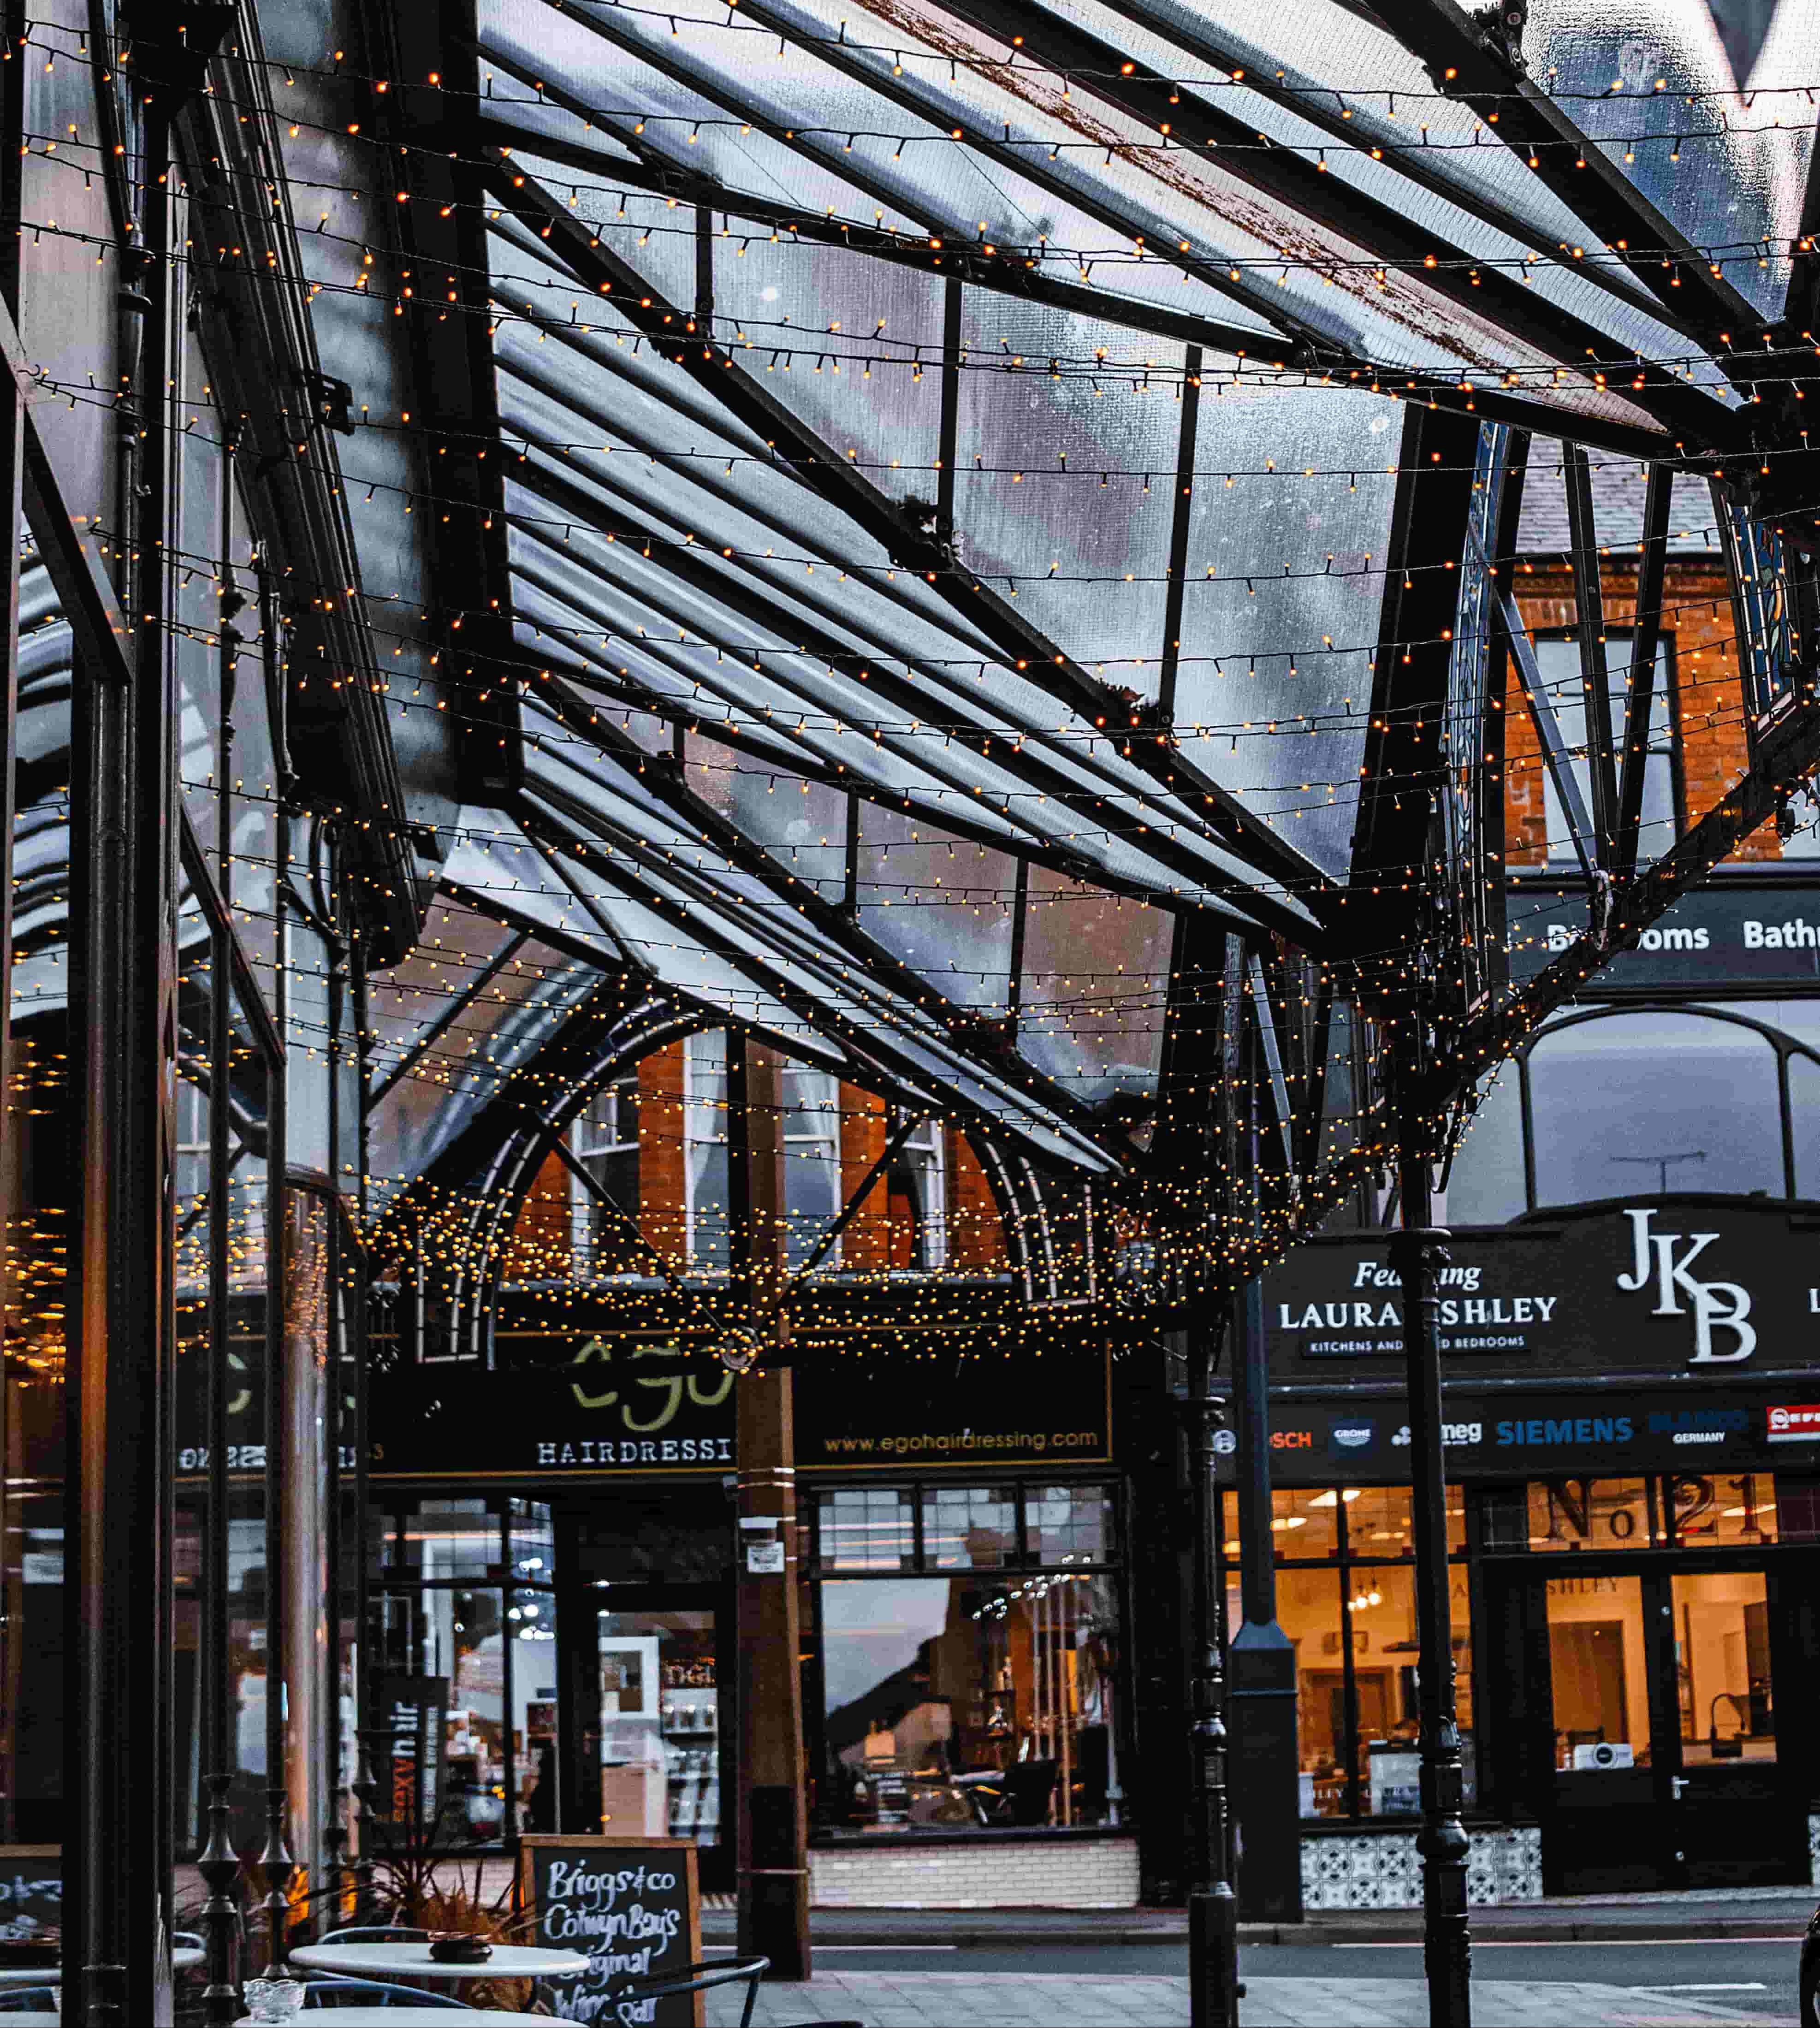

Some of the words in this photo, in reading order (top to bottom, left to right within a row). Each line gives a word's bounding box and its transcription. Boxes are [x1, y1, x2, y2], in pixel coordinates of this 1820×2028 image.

[1547, 925, 1711, 952] Boms
[1743, 918, 1820, 949] Bath
[1354, 1262, 1482, 1291] Feaing
[1616, 1209, 1757, 1363] JKB
[1280, 1302, 1402, 1328] LAURA
[1441, 1297, 1557, 1326] SHLEY
[1310, 1340, 1372, 1352] KITCHENS
[1377, 1340, 1404, 1351] AND
[1455, 1335, 1525, 1348] BEDROOMS
[824, 1431, 1098, 1453] www.egohairdressing.com
[1270, 1431, 1312, 1449] SCH
[1334, 1428, 1371, 1438] GROHE
[1440, 1423, 1482, 1443] meg
[1495, 1417, 1634, 1446] SIEMENS
[1672, 1431, 1725, 1444] GERMANY
[537, 1438, 732, 1464] HAIRDRESSI
[1672, 1475, 1761, 1537] 21
